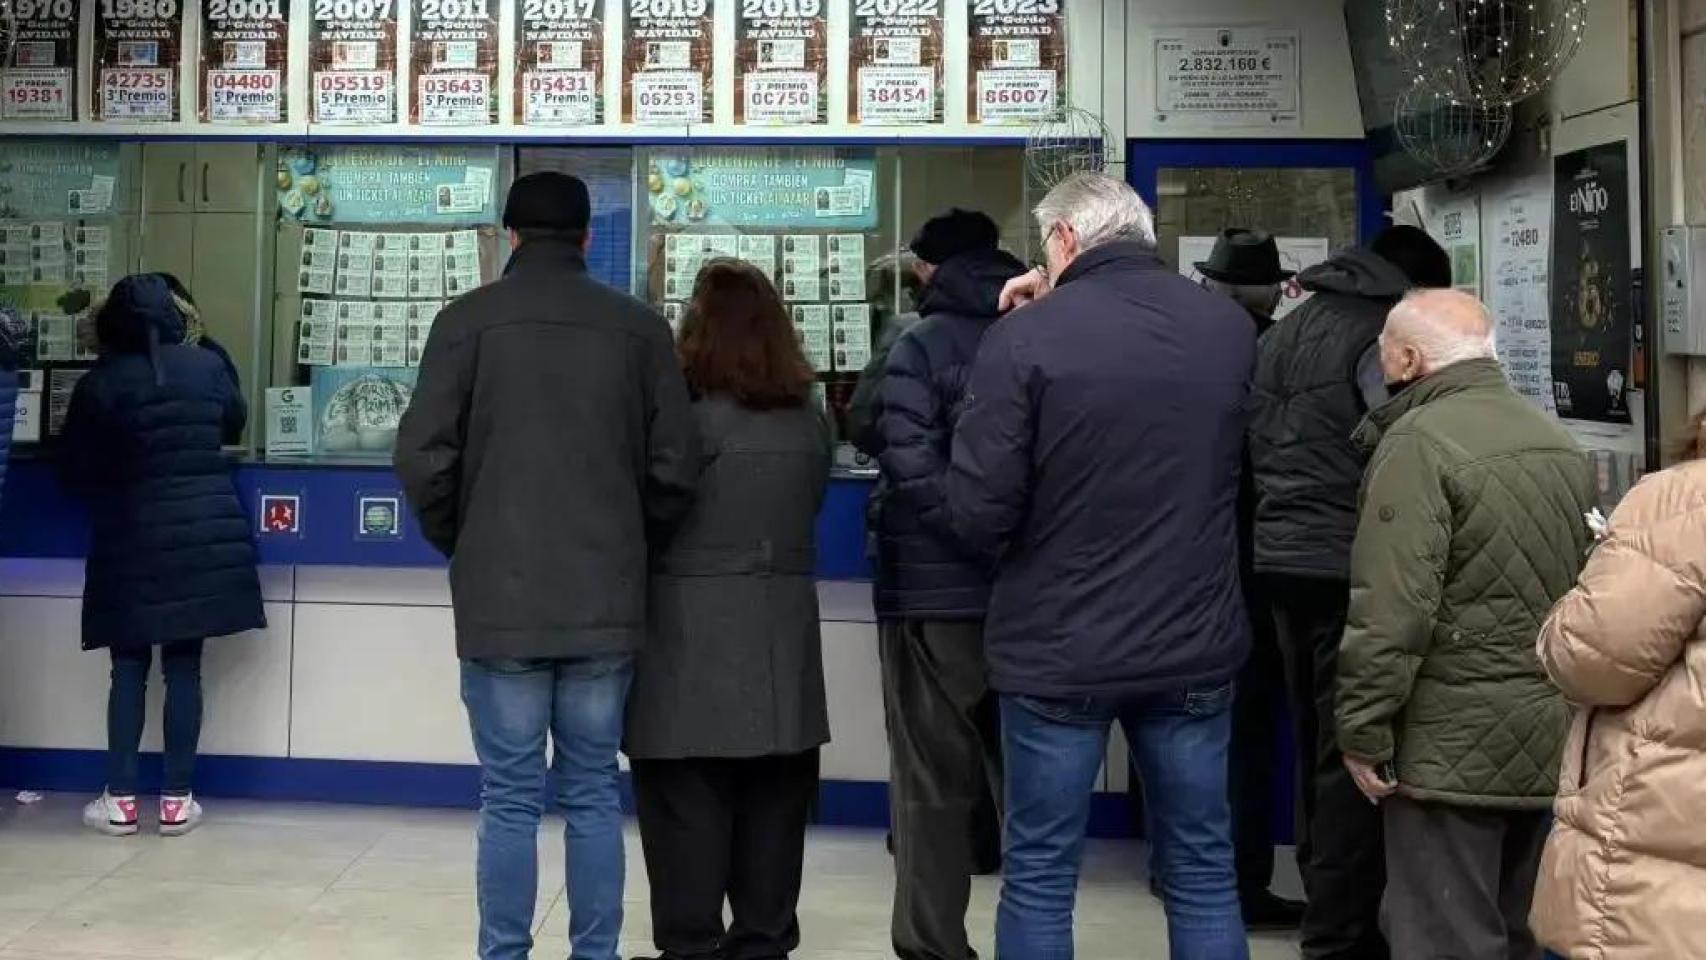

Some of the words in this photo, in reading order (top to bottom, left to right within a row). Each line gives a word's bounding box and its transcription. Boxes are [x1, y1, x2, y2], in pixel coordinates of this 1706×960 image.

[101, 0, 176, 18] 1980
[209, 0, 282, 20] 2001
[315, 0, 393, 20] 2007
[421, 0, 489, 20] 2011
[524, 0, 594, 20] 2017
[631, 0, 706, 17] 2019
[743, 0, 820, 17] 2019
[855, 0, 938, 15] 2022
[106, 30, 170, 38] NAVIDAD
[212, 31, 277, 39] NAVIDAD
[322, 31, 385, 39] NAVIDAD
[422, 31, 487, 40] NAVIDAD
[526, 31, 592, 40] NAVIDAD
[634, 29, 700, 37] NAVIDAD
[746, 30, 815, 38] NAVIDAD
[861, 28, 931, 36] NAVIDAD
[980, 27, 1051, 36] NAVIDAD
[1179, 57, 1257, 71] 2.832.160
[1261, 57, 1272, 71] €
[107, 73, 165, 88] 42735
[214, 75, 272, 89] 04480
[321, 76, 384, 91] 05519
[425, 79, 483, 93] 03643
[530, 77, 588, 92] 05431
[8, 89, 63, 102] 19381
[120, 90, 166, 101] Premio
[226, 92, 274, 103] Premio
[335, 93, 386, 104] Premio
[438, 95, 483, 106] Premio
[544, 92, 590, 103] Premio
[867, 88, 926, 102] 38454
[985, 90, 1048, 104] 86007
[712, 174, 756, 187] COMPRA
[730, 190, 763, 204] TICKET
